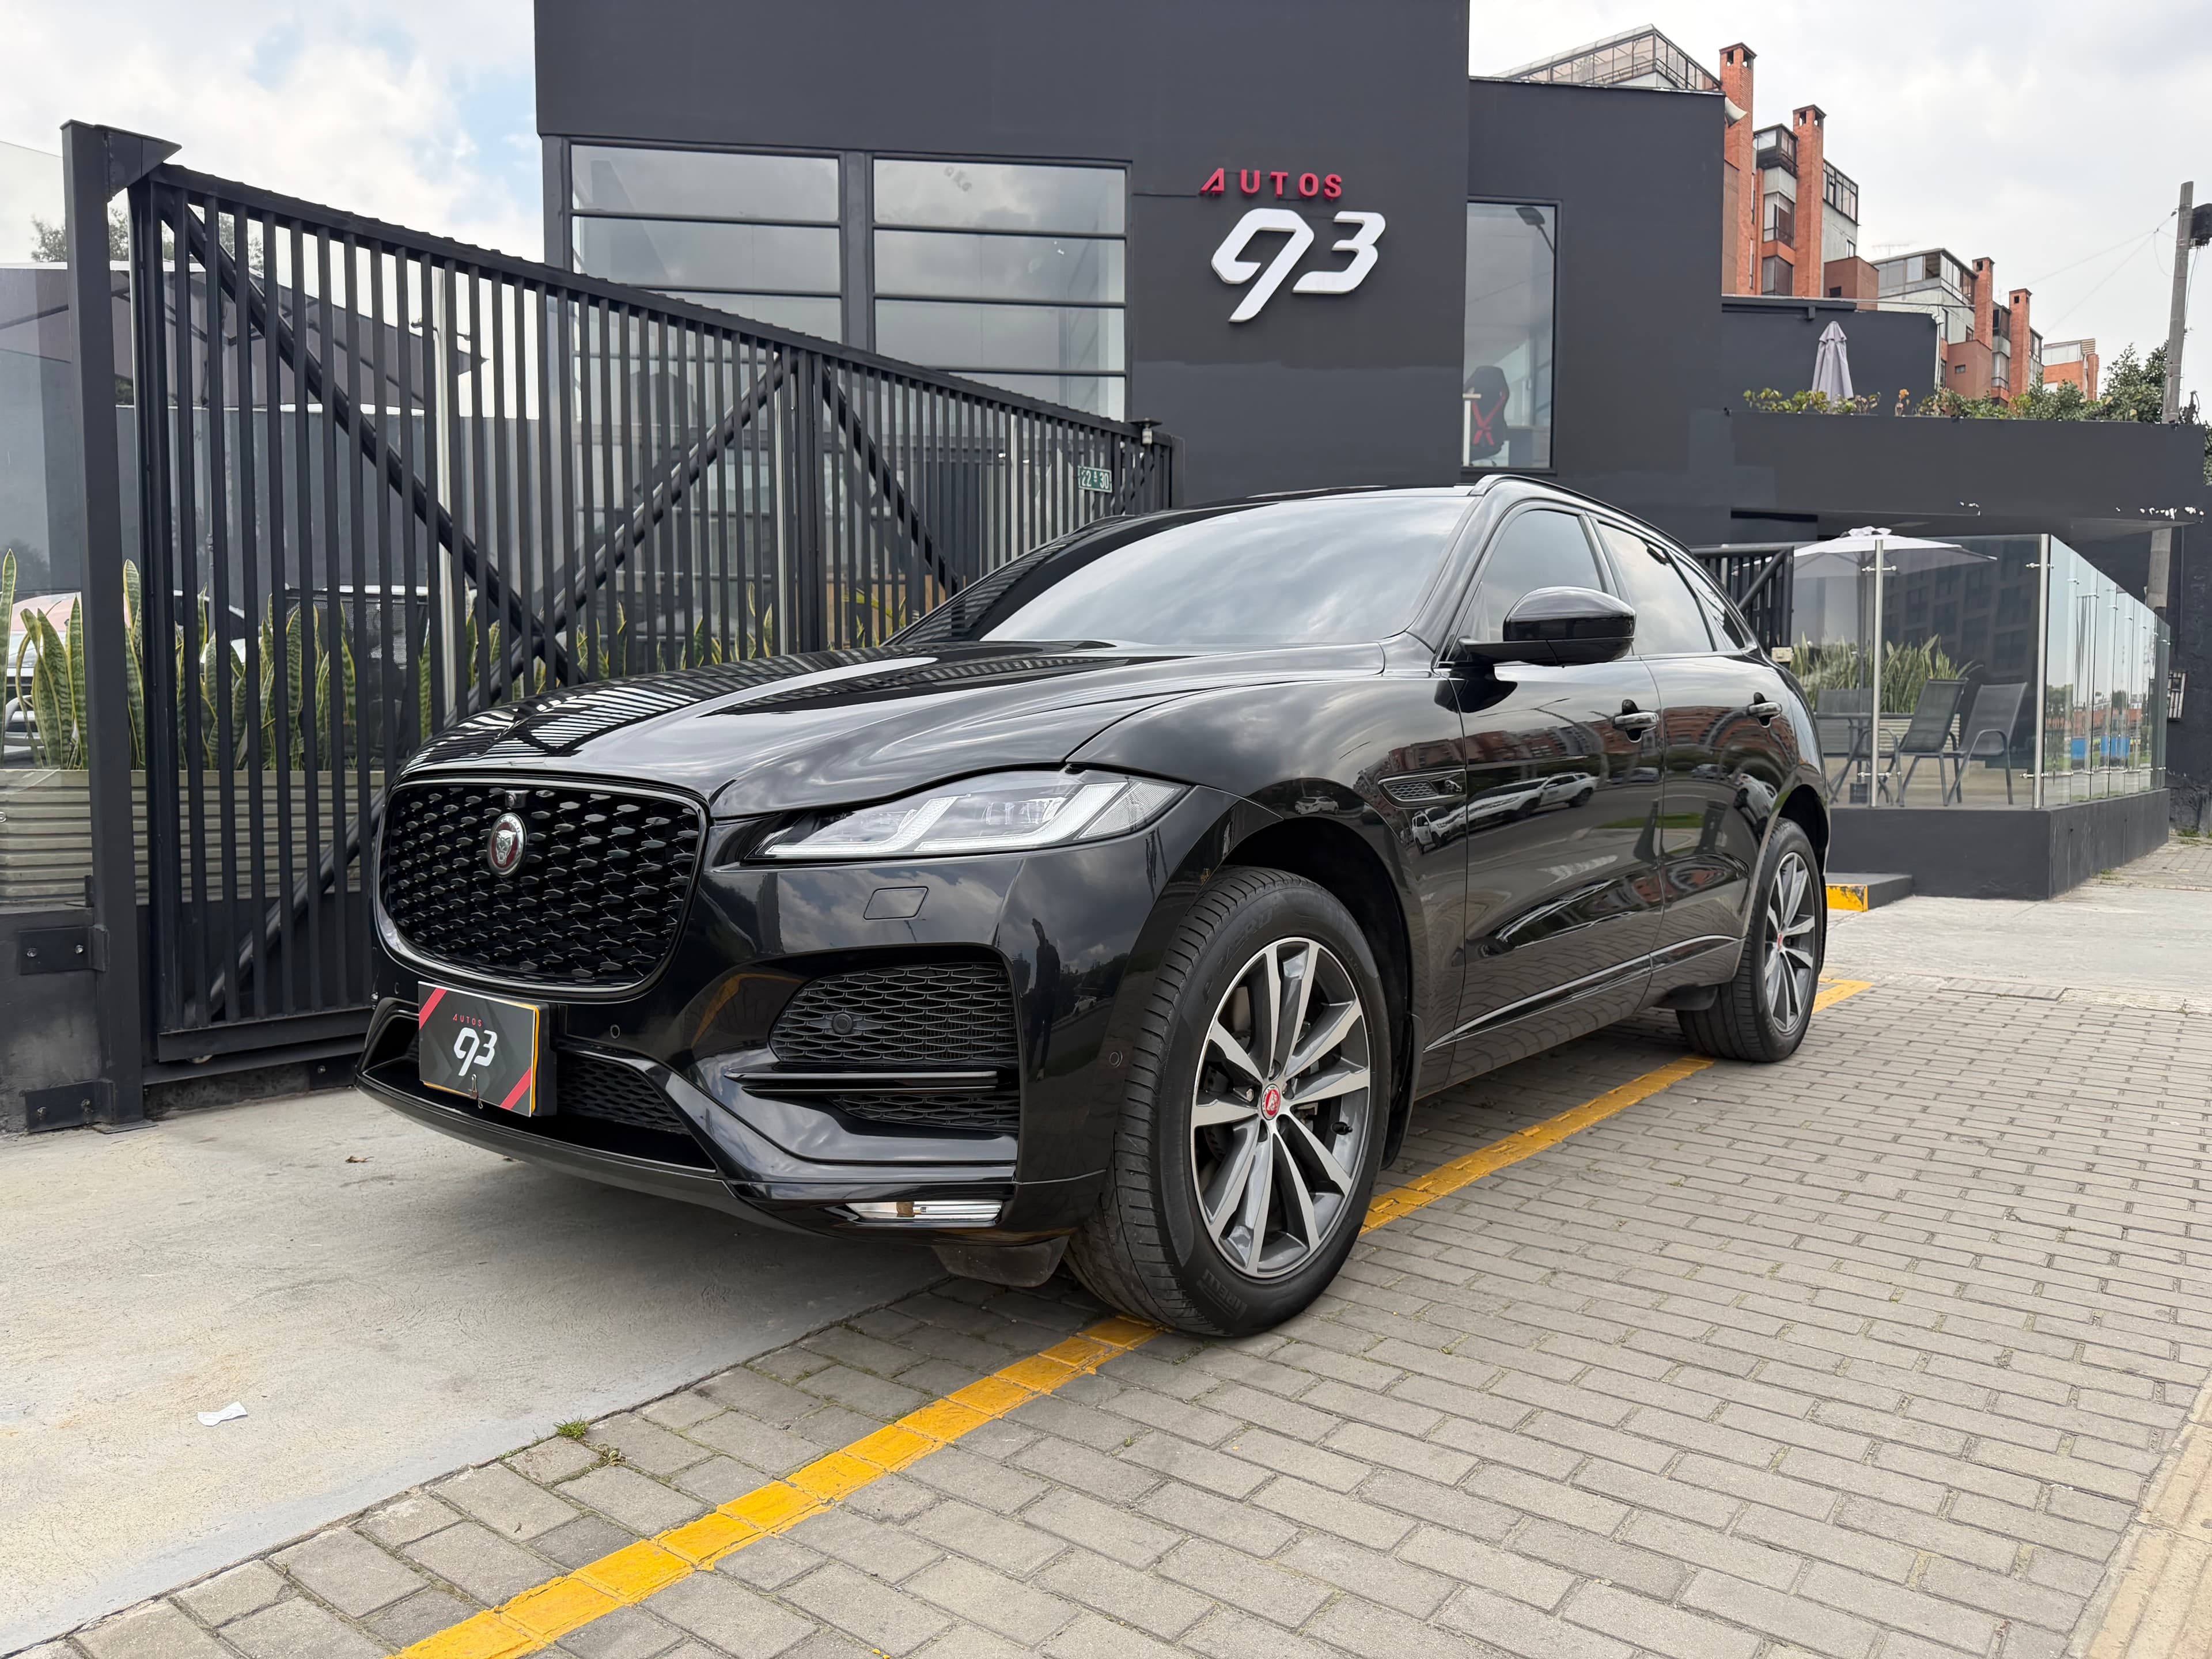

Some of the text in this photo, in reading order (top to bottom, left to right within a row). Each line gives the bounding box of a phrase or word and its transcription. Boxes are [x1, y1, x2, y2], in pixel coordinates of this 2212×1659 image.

[1200, 168, 1342, 199] AUTOS
[1210, 207, 1386, 323] 93
[453, 1013, 483, 1027] AUTOS
[453, 1027, 498, 1076] 93
